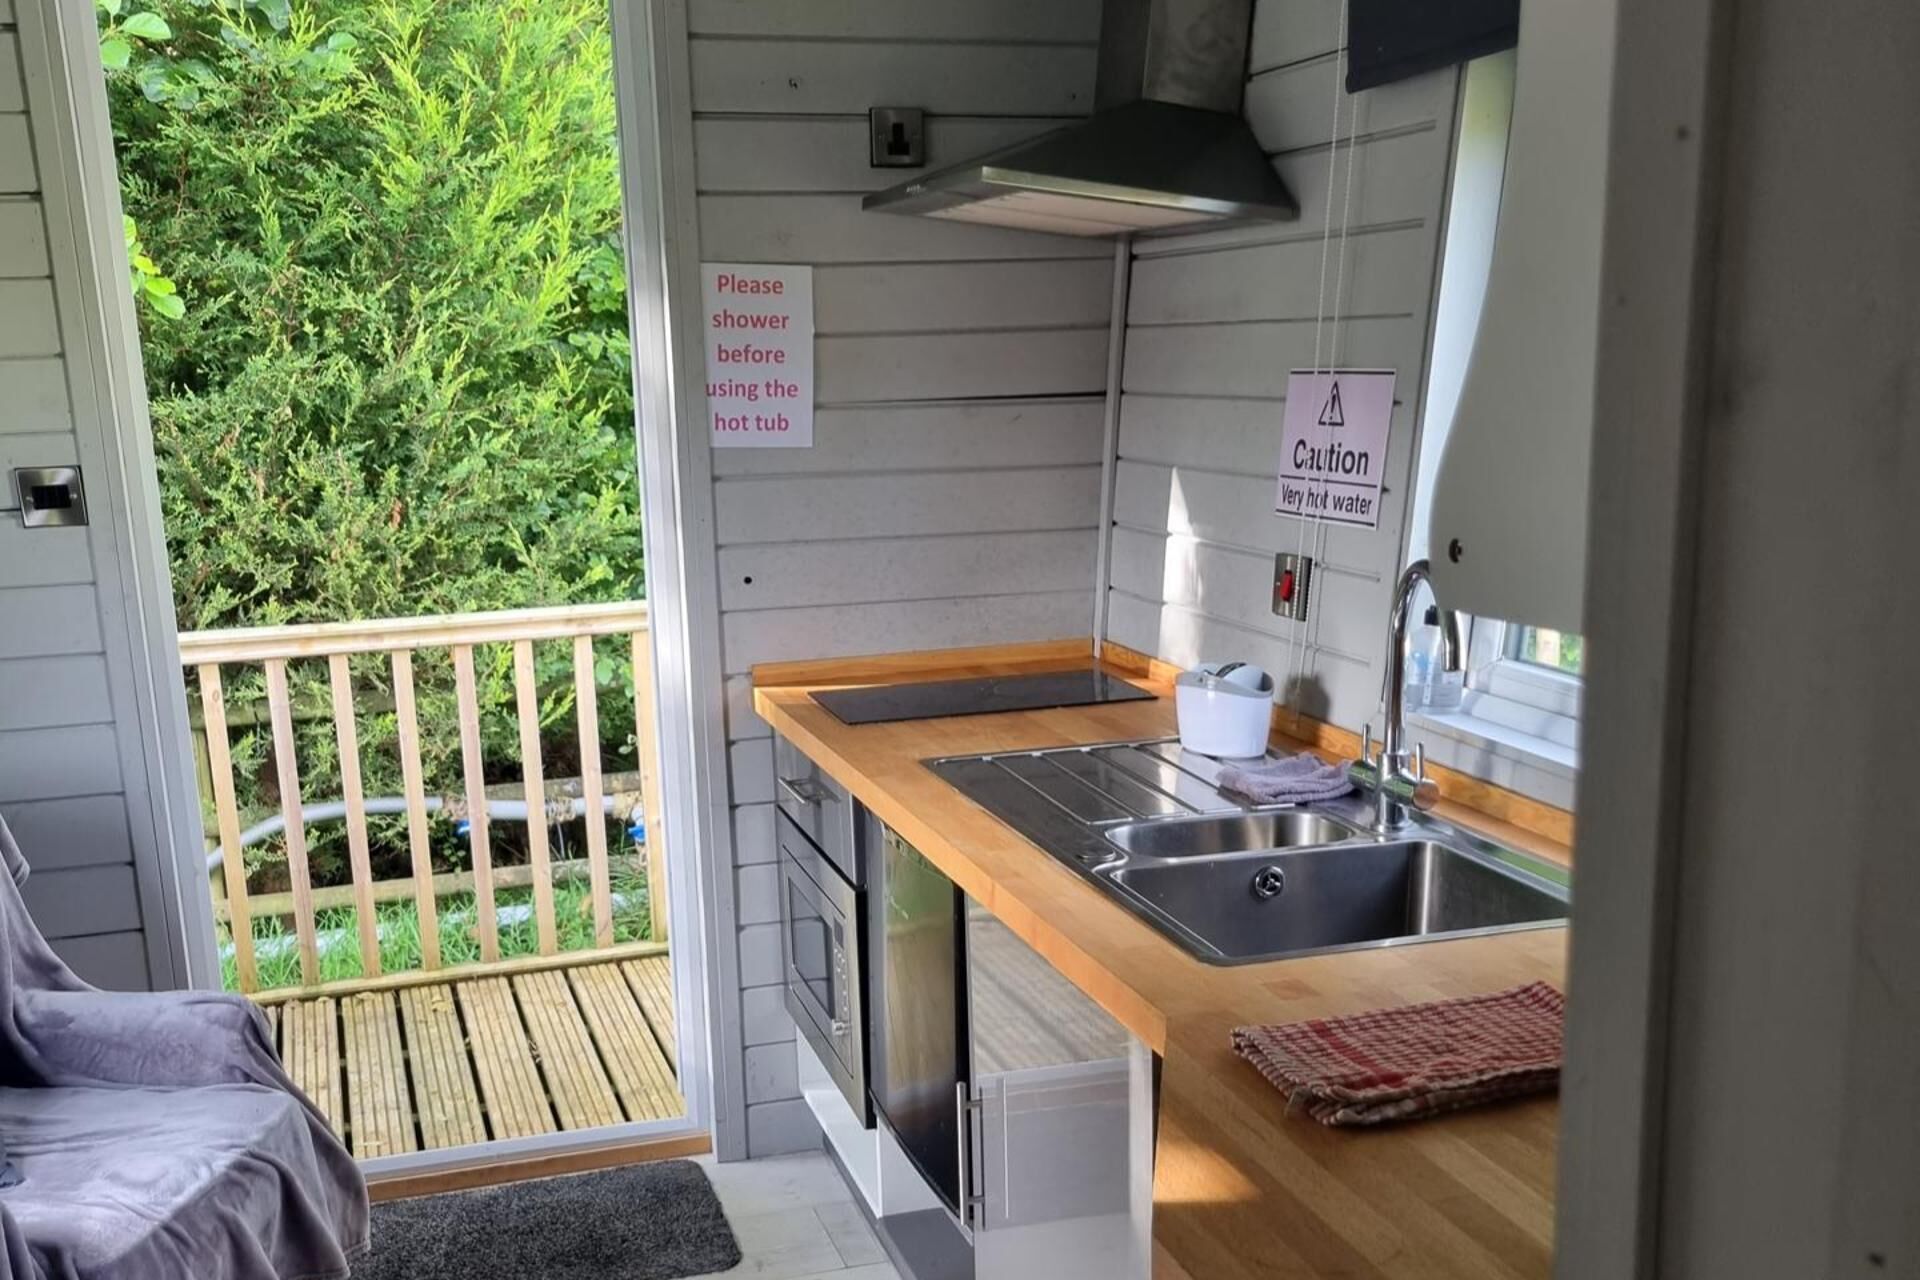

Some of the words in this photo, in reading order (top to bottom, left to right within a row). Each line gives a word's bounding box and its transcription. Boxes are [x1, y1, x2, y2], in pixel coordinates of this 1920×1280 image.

[717, 274, 784, 295] Please
[712, 309, 790, 329] shower
[717, 344, 786, 364] before
[705, 379, 758, 401] using
[764, 379, 799, 398] the
[714, 413, 749, 432] hot
[755, 413, 789, 432] tub
[1293, 438, 1369, 476] Caution
[1282, 484, 1304, 510] Very
[1306, 487, 1329, 510] hot
[1333, 493, 1372, 516] water
